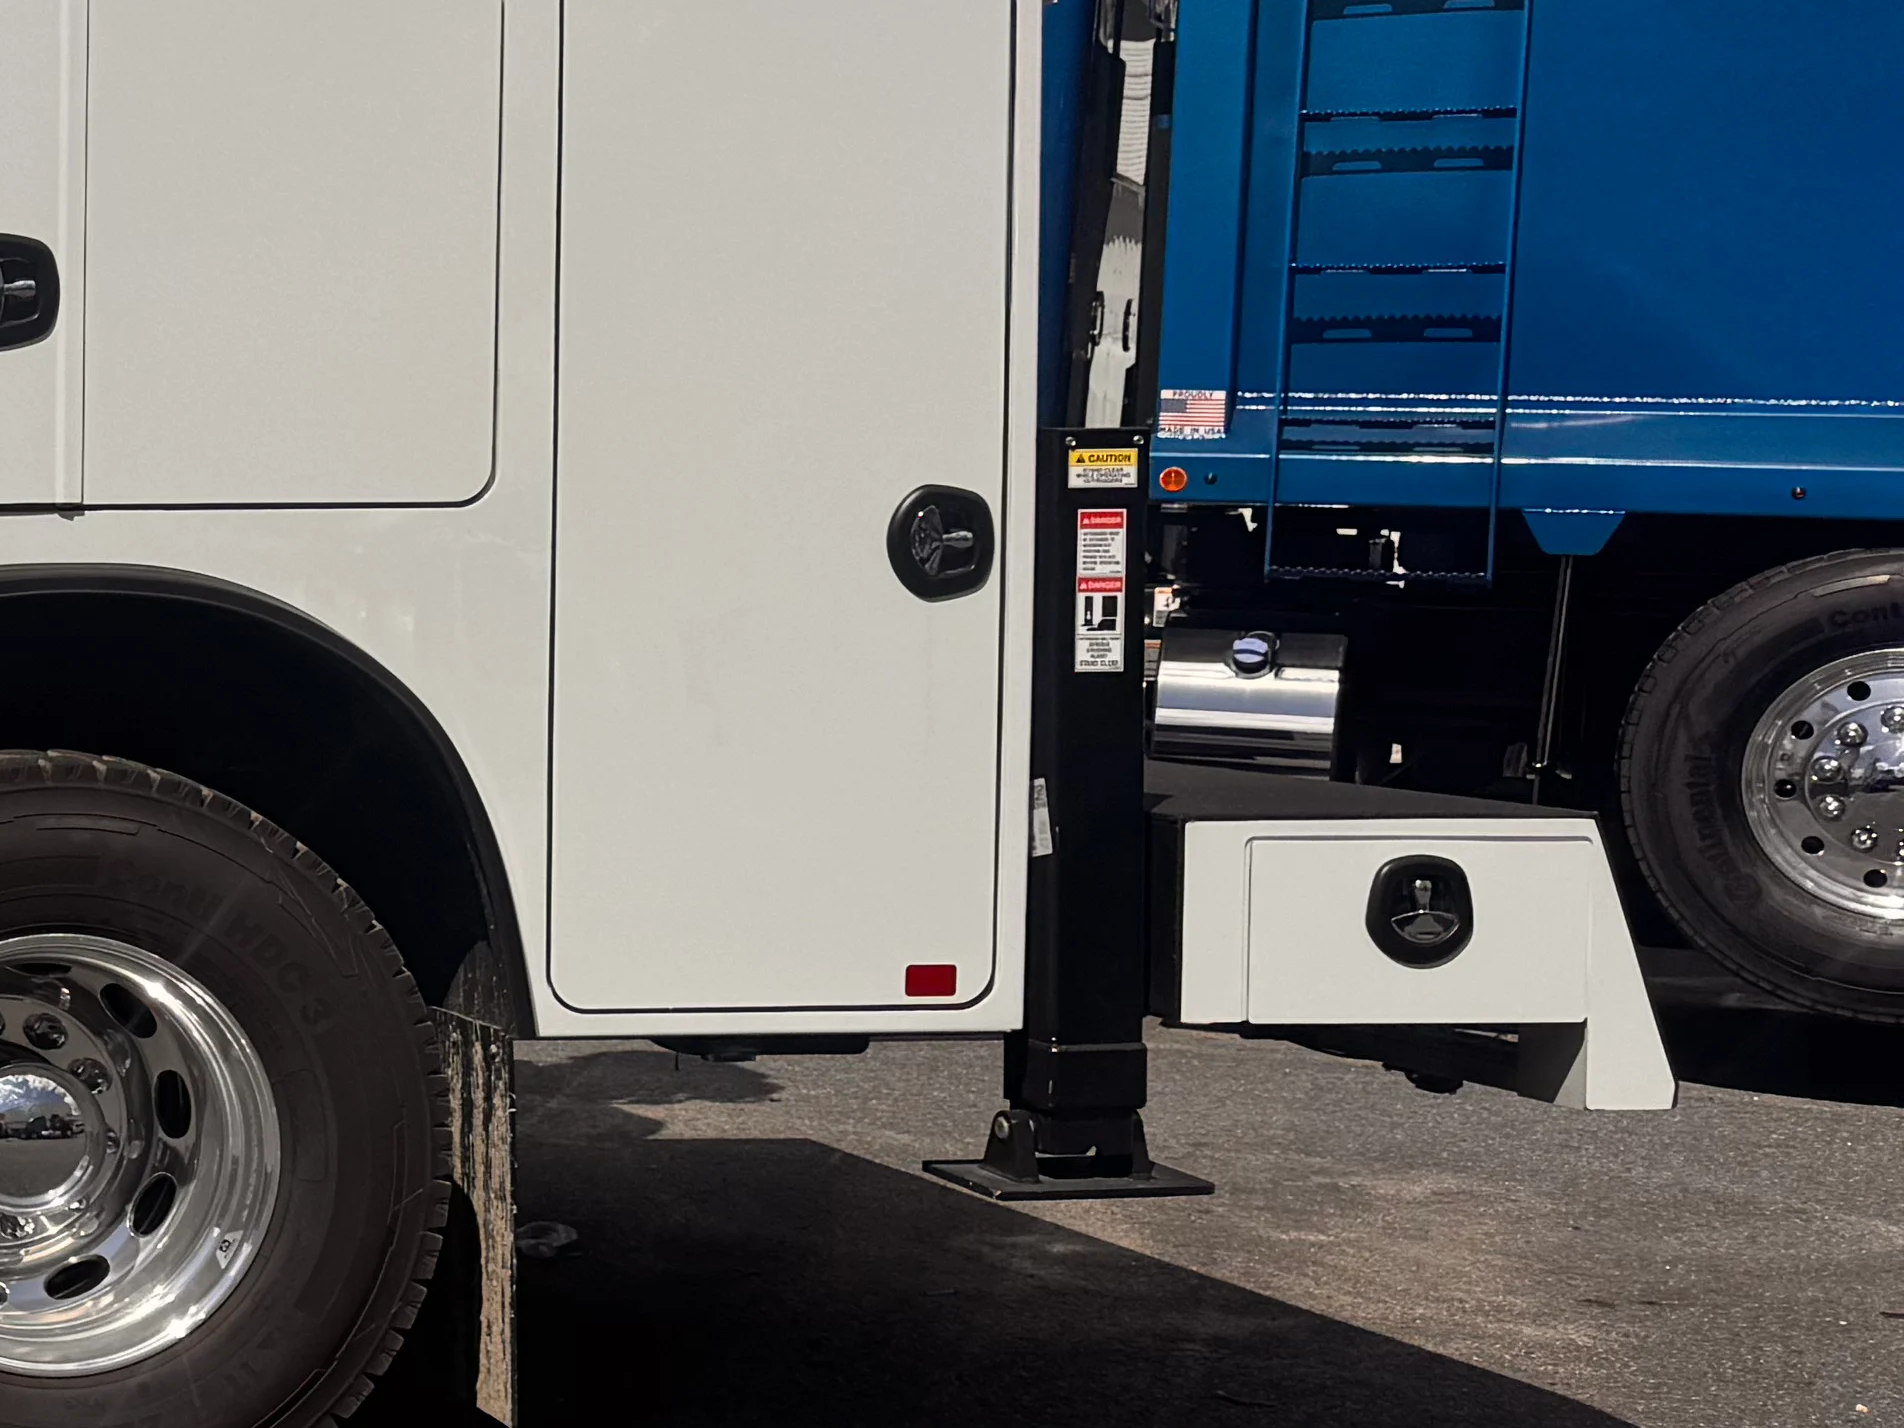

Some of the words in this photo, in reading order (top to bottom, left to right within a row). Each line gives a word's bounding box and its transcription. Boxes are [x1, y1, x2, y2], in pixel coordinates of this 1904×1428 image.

[1172, 390, 1214, 399] PROUDLY
[1088, 453, 1132, 464] CAUTION
[225, 910, 307, 996] HDC
[299, 996, 331, 1033] 3
